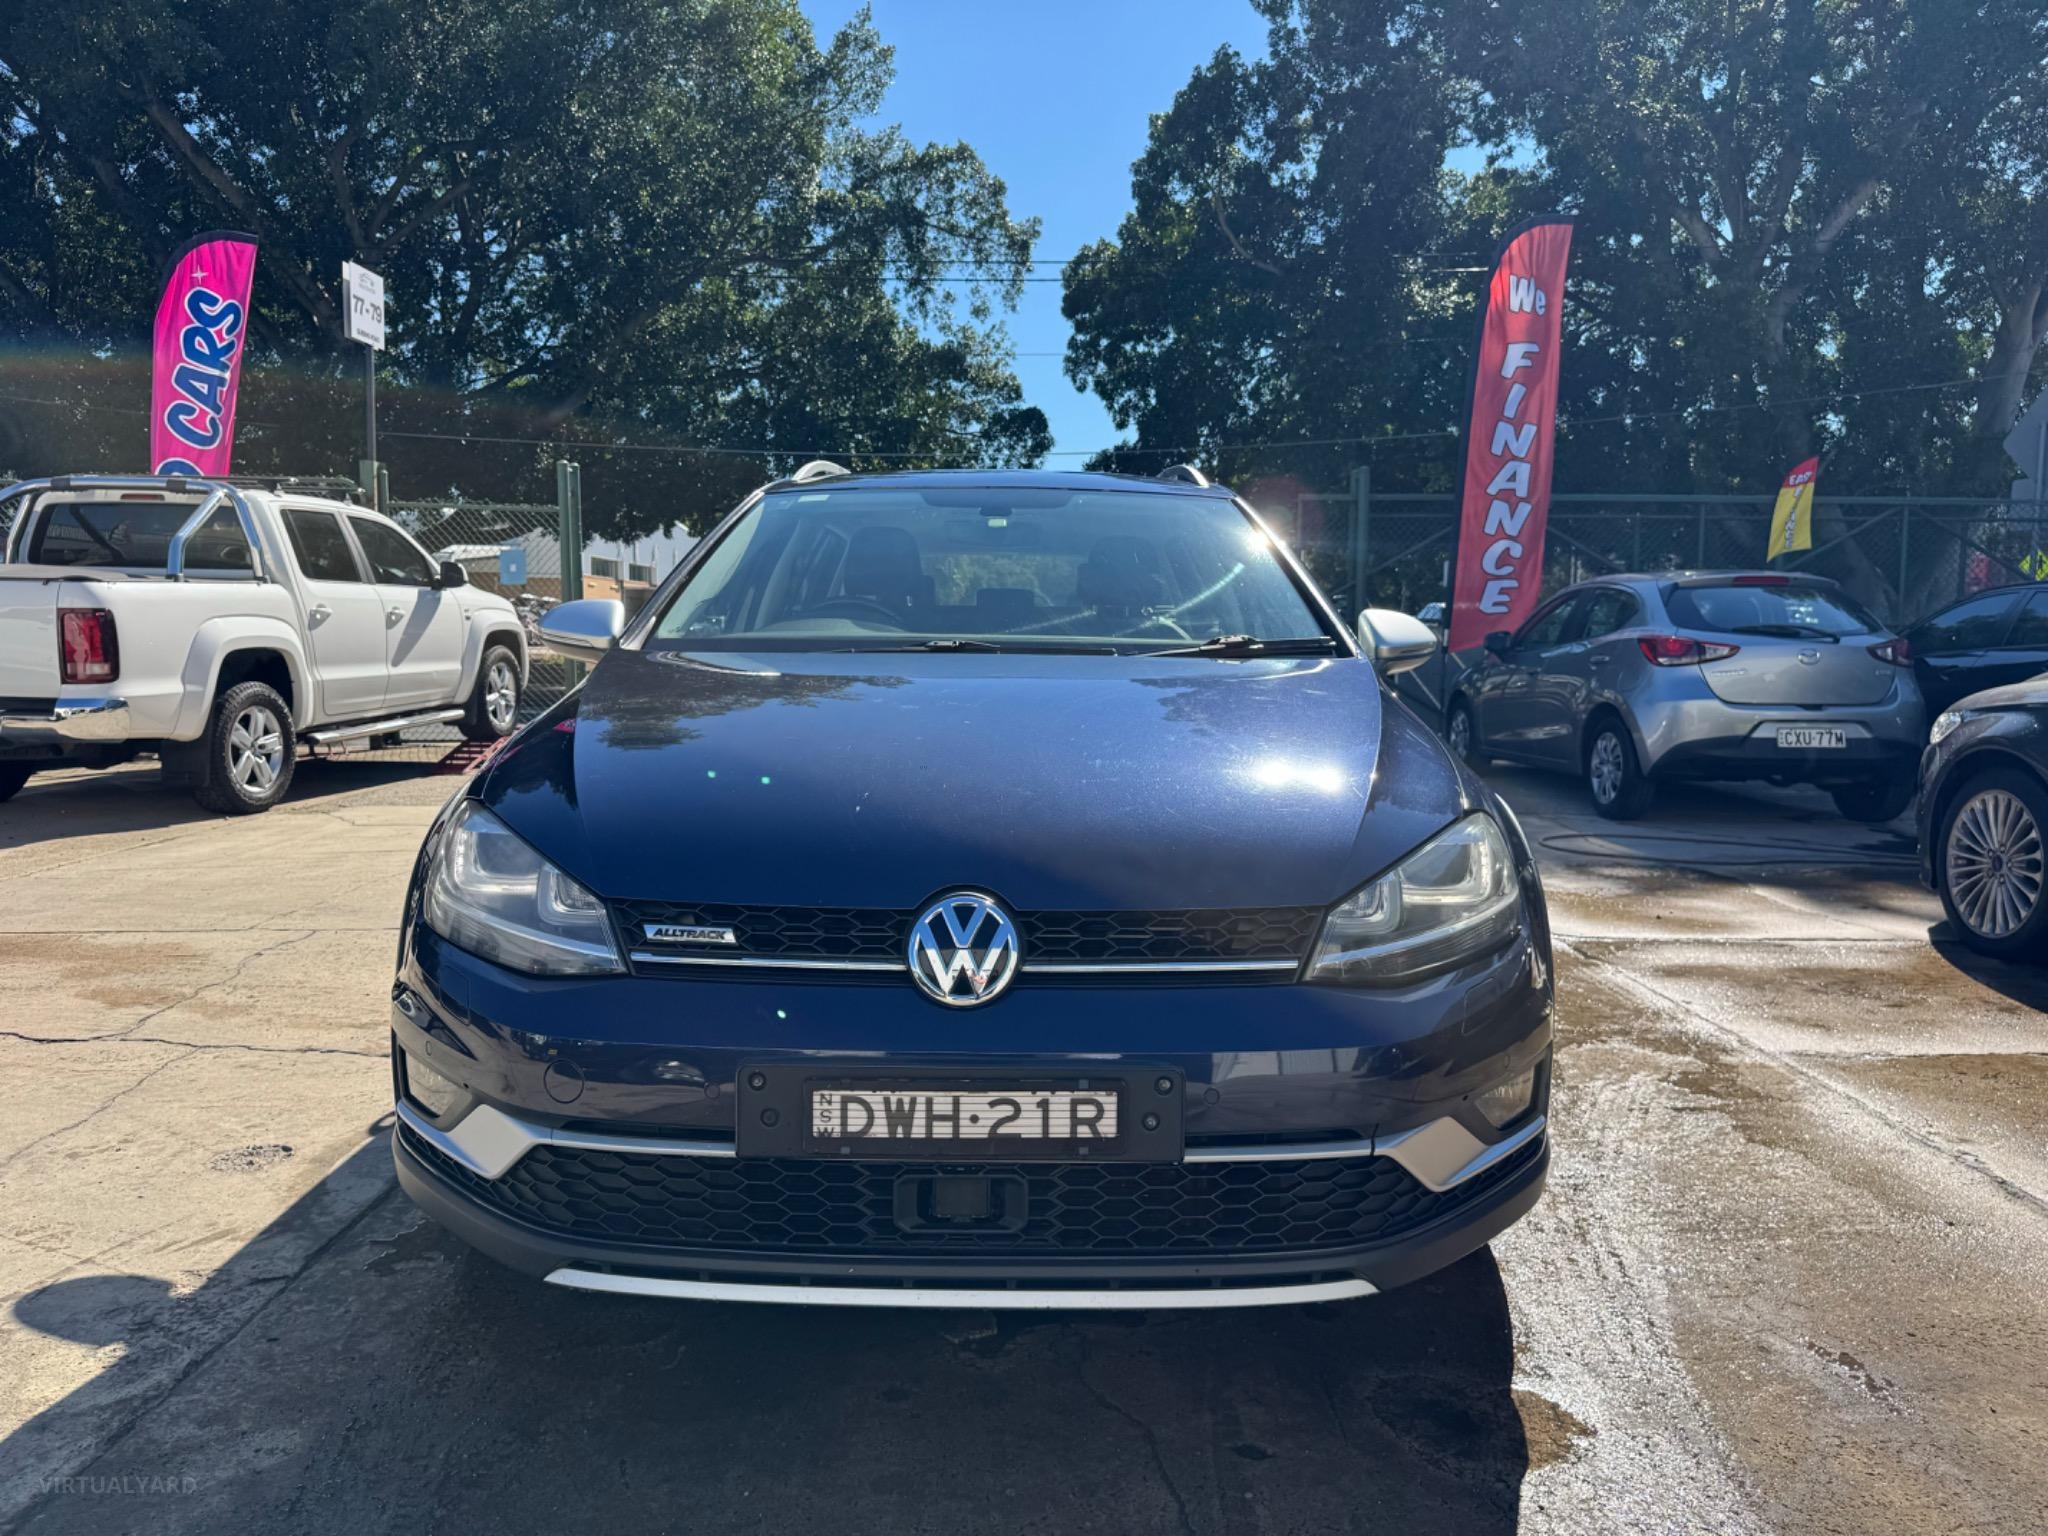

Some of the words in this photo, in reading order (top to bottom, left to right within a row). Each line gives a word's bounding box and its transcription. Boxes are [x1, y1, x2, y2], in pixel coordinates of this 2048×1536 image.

[1508, 273, 1547, 317] We
[163, 285, 244, 450] CARS
[1478, 341, 1541, 616] FINANCE
[652, 926, 727, 941] ALLTRACK
[816, 1093, 835, 1138] NSW
